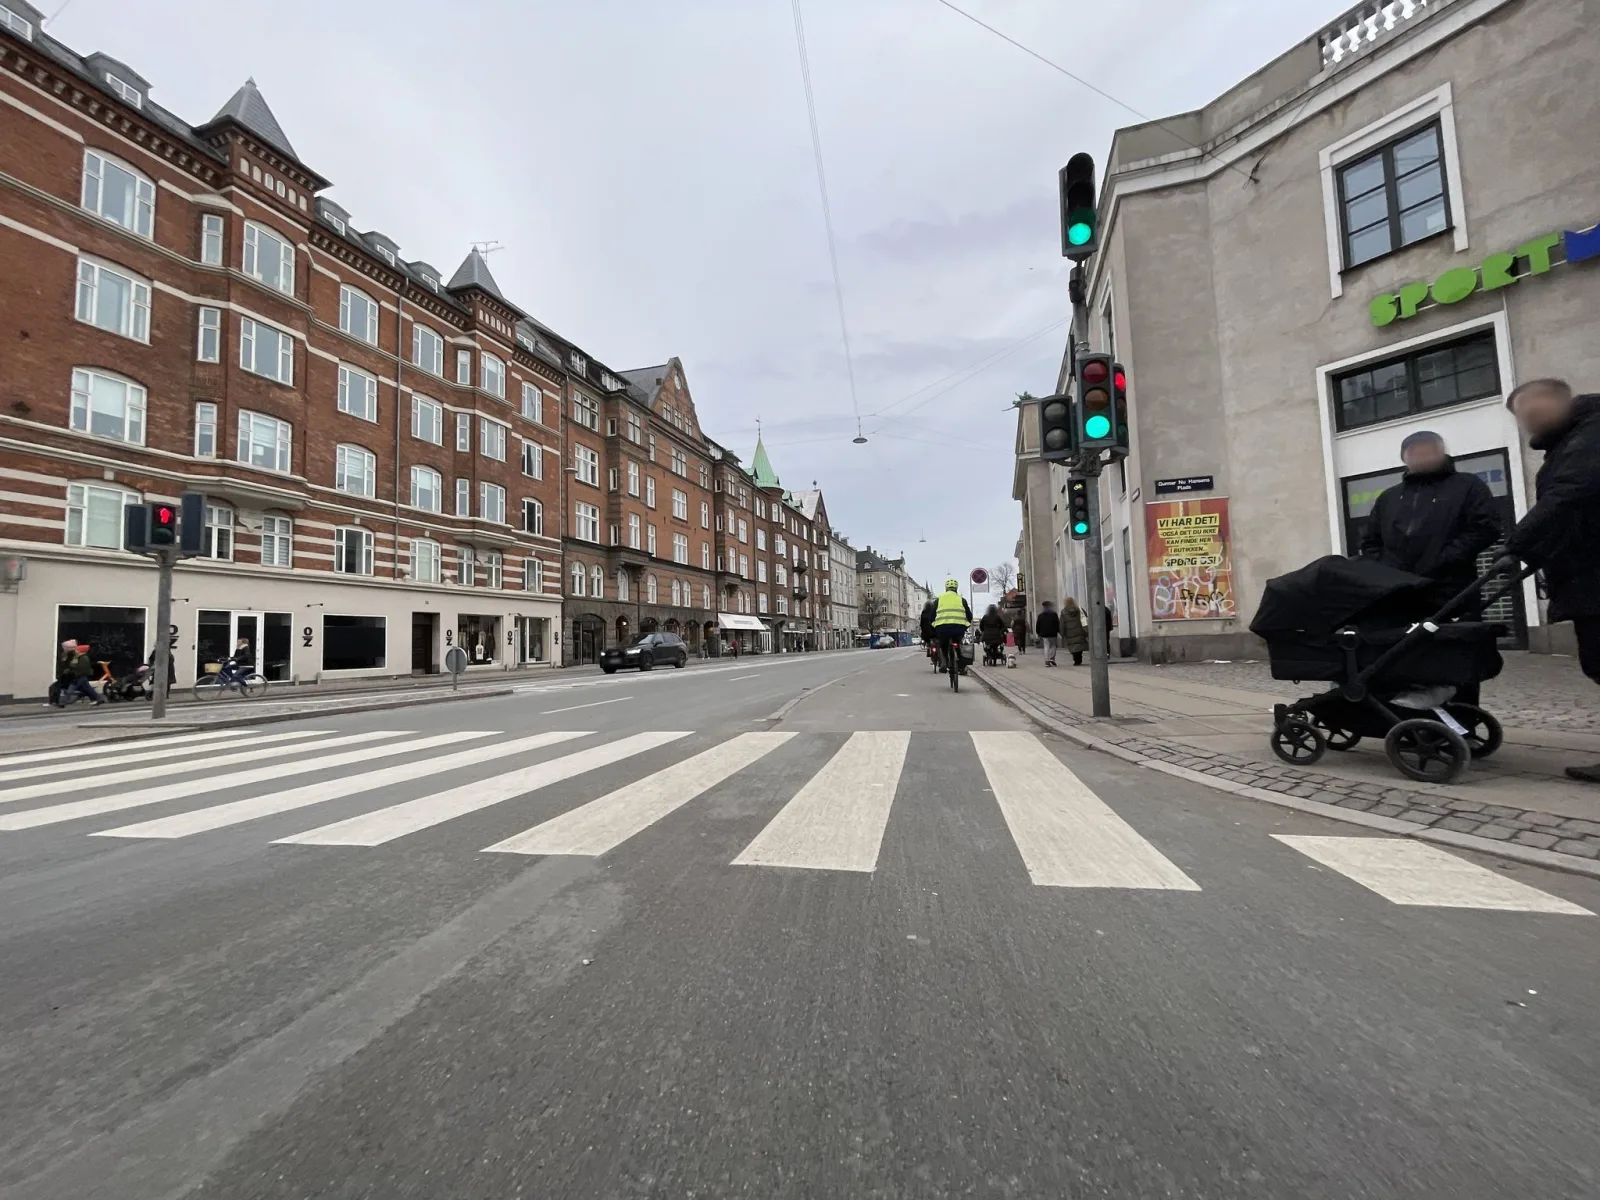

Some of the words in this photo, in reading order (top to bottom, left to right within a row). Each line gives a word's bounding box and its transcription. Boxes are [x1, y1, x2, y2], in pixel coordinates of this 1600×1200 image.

[1159, 519, 1169, 527] VI
[1171, 517, 1192, 526] HAR
[1194, 515, 1217, 525] DET!
